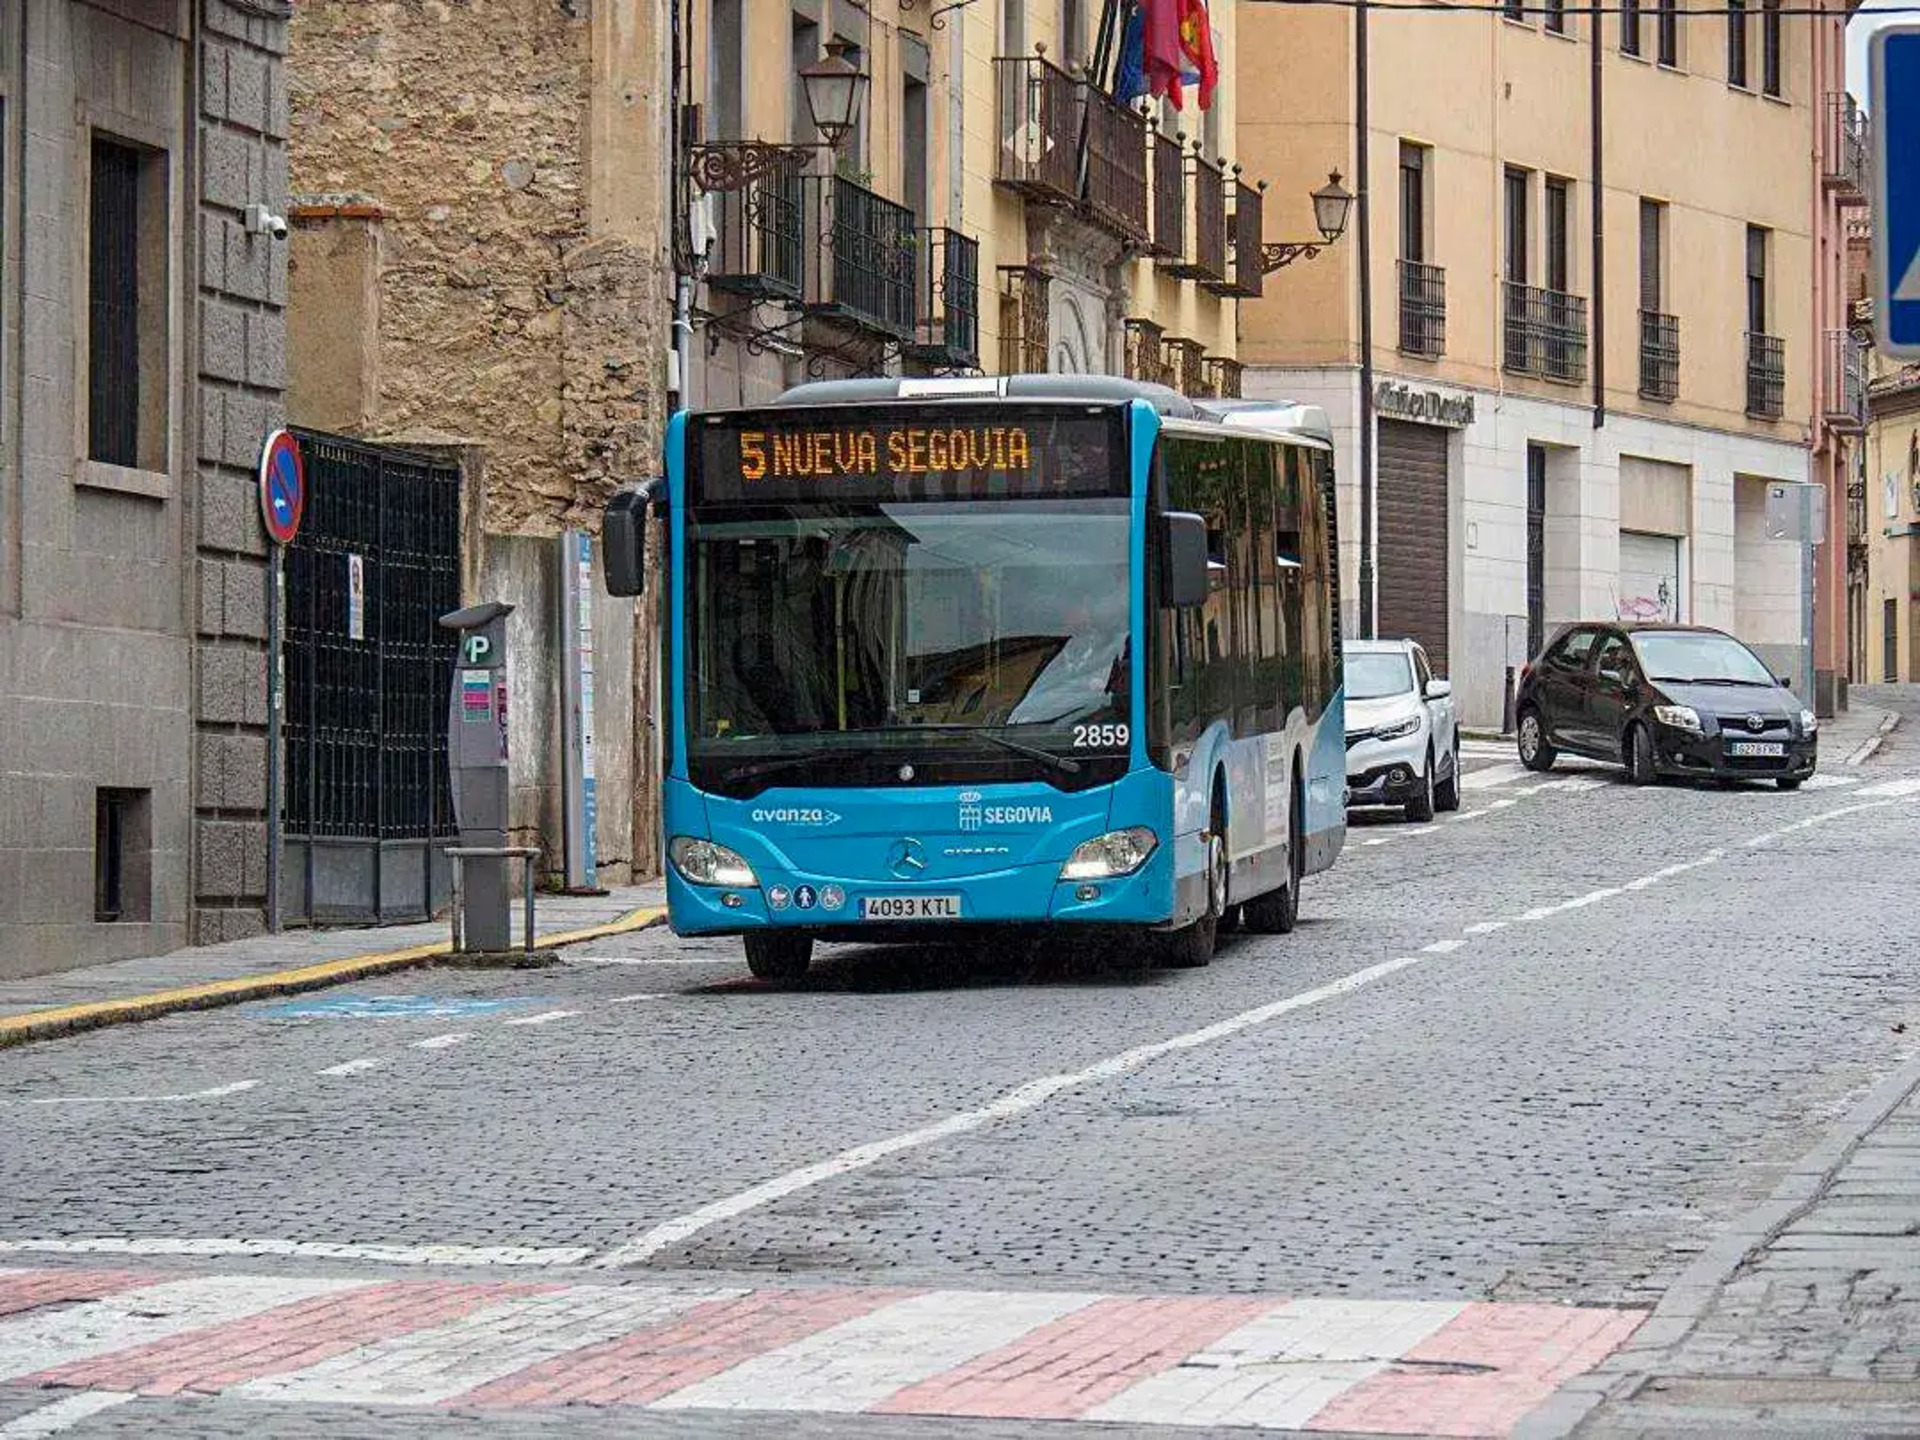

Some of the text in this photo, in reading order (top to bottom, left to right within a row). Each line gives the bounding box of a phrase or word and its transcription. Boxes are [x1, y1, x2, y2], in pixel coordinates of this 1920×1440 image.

[740, 427, 1030, 480] 5 NUEVA SEGOVIA
[470, 636, 490, 663] P
[1072, 724, 1130, 747] 2859
[751, 808, 823, 823] avanza
[983, 806, 1053, 824] SEGOVIA
[868, 897, 957, 917] 4093 KTL
